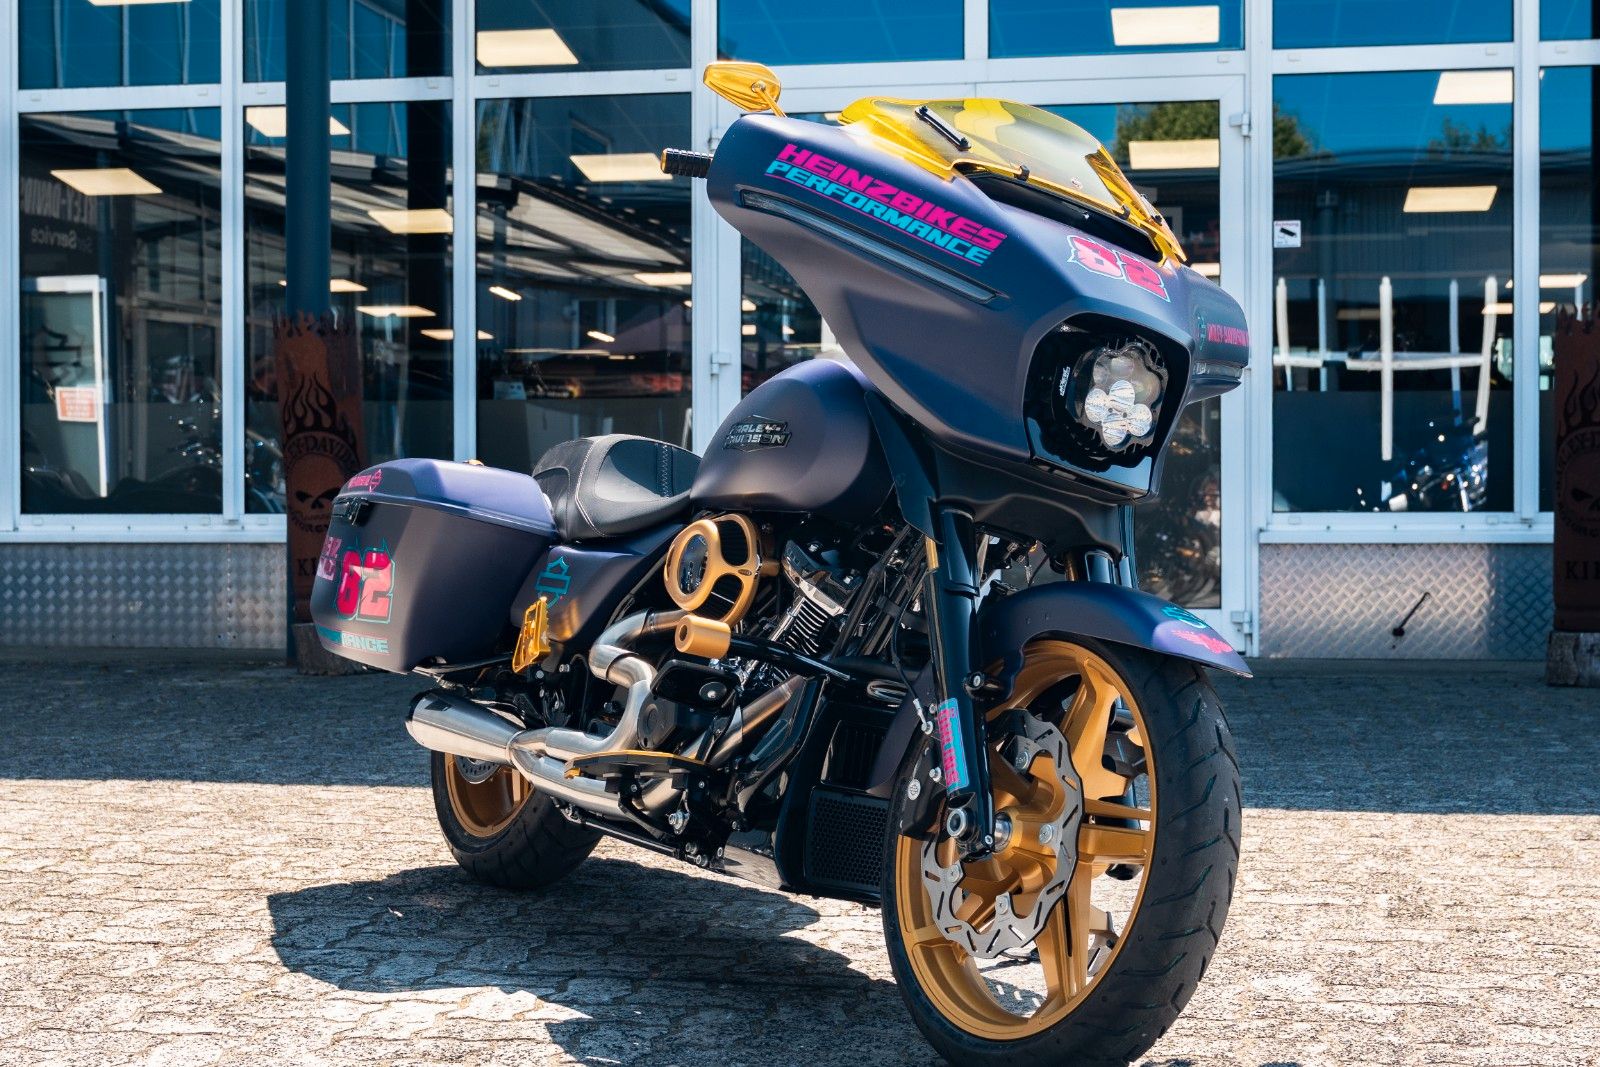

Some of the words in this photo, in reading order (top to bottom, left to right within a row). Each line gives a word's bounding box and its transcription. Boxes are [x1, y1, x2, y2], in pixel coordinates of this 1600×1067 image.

[766, 159, 992, 265] PERFORMANCE
[776, 143, 1008, 251] HEINZBIKES
[335, 546, 395, 622] 62
